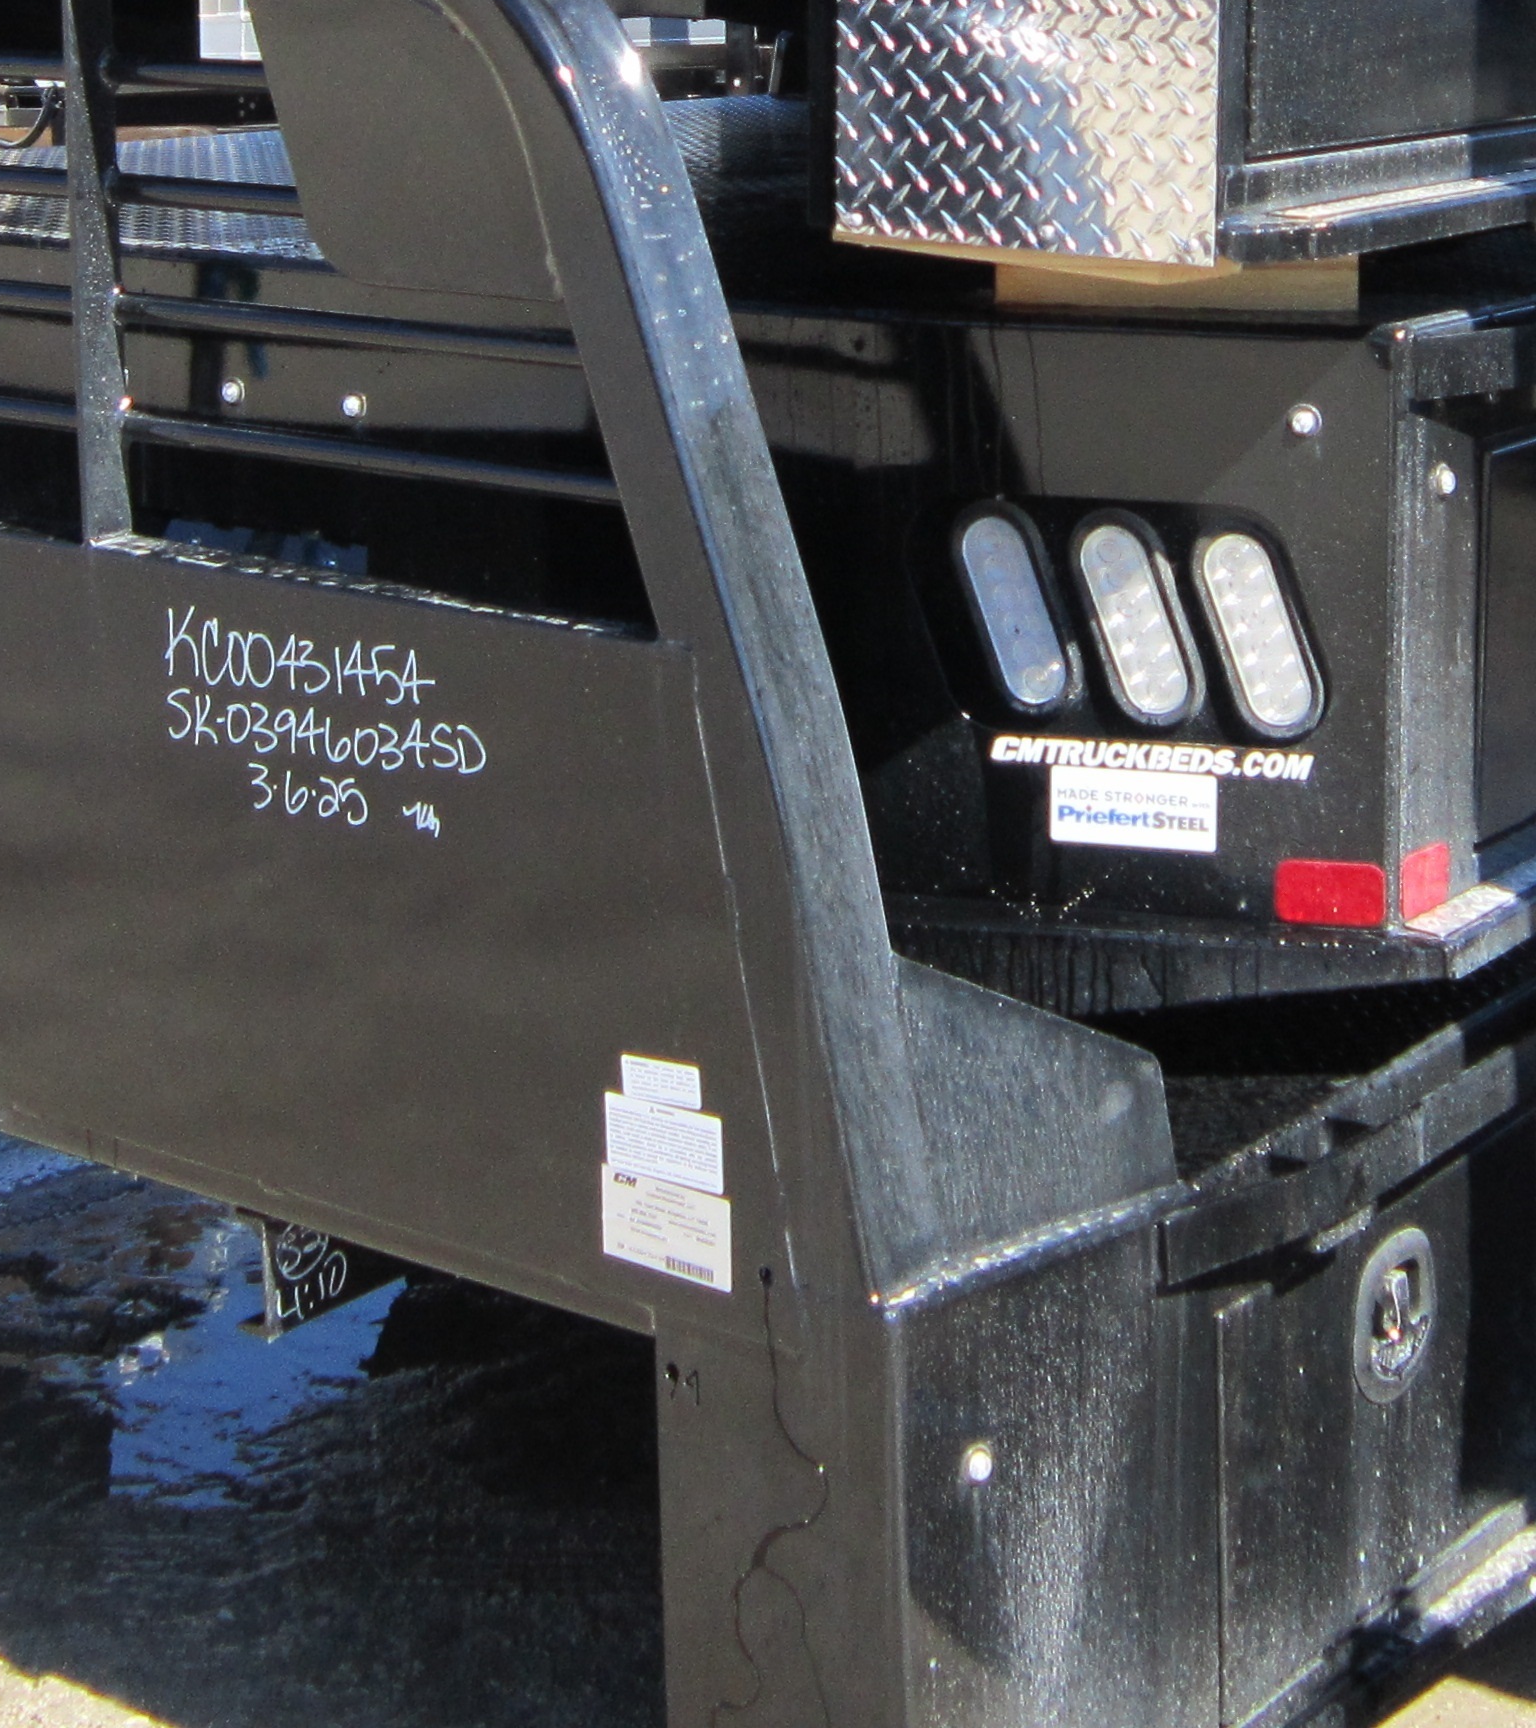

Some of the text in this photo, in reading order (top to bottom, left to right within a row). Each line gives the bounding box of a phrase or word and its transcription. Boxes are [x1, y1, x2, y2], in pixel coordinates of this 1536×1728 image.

[990, 736, 1315, 781] CMTRUCKBEDS.COM
[1056, 788, 1099, 801] MADE
[1104, 790, 1189, 807] STRONGER
